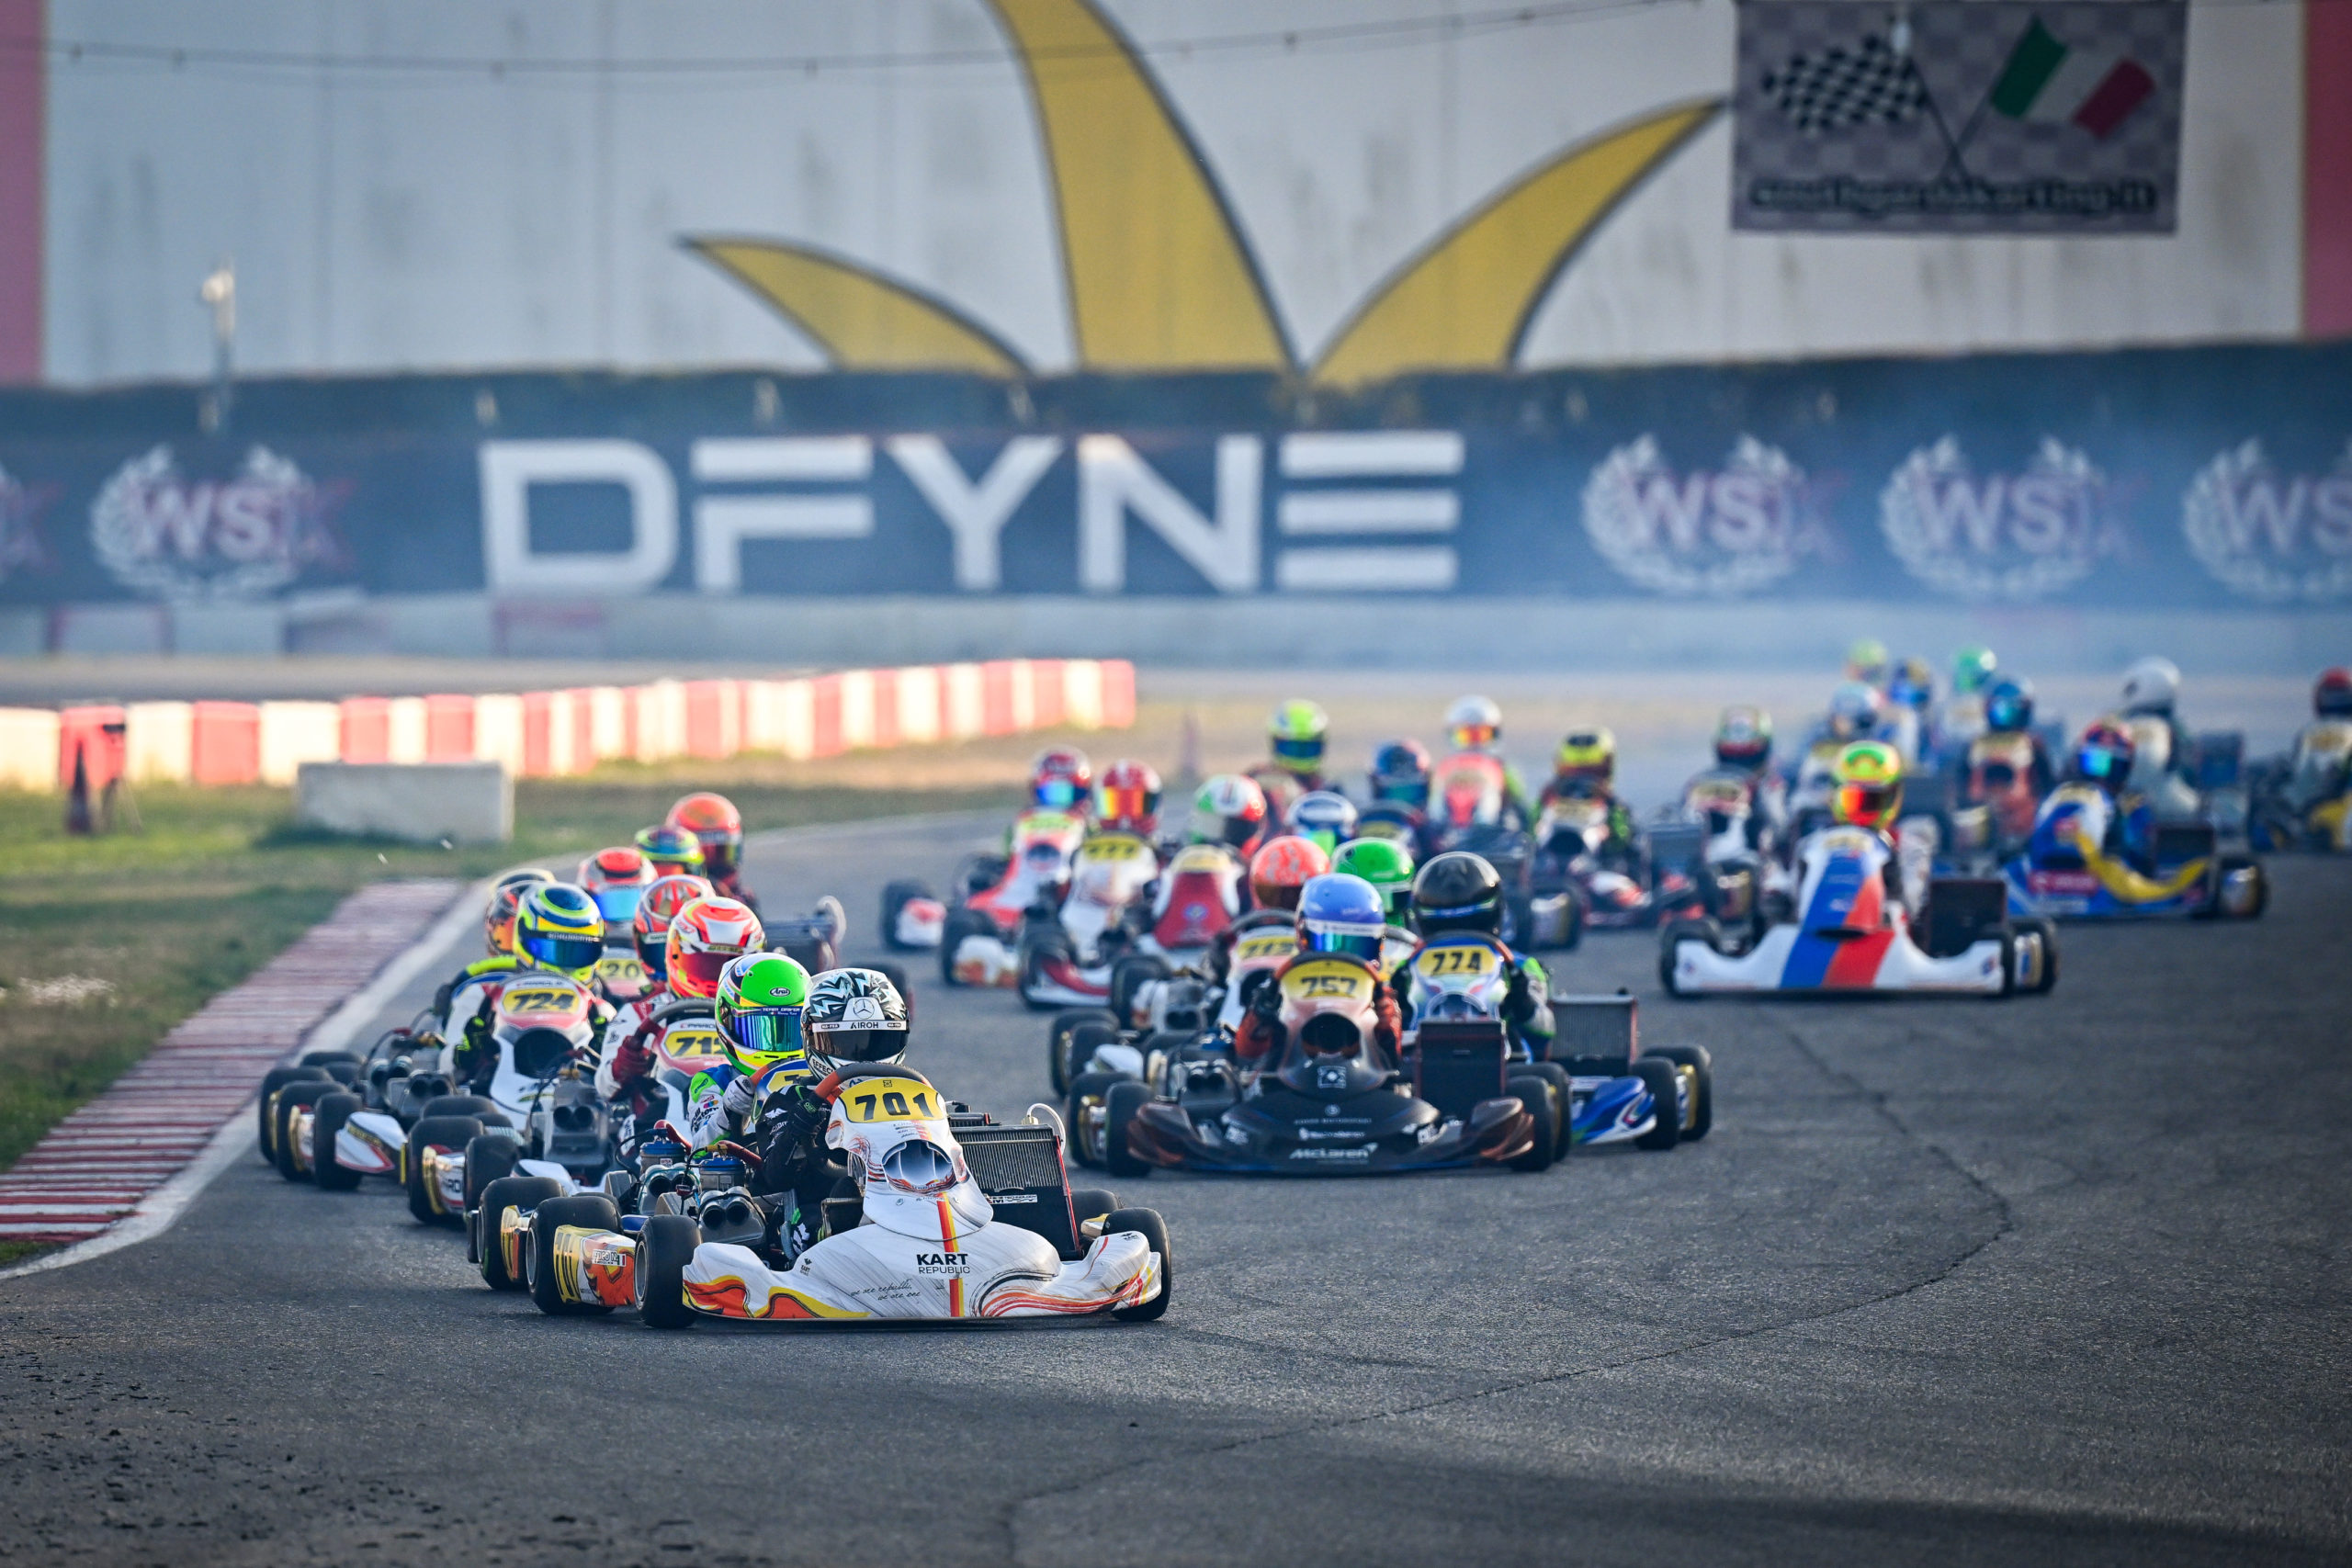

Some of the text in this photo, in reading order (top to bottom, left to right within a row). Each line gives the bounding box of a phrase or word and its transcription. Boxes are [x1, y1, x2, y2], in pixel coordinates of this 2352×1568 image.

[481, 433, 1463, 593] DFYNE
[1432, 952, 1481, 972] 774
[1301, 976, 1357, 995] 757
[855, 1092, 934, 1121] 701
[916, 1253, 968, 1266] KART
[919, 1266, 970, 1274] REPUBLIC
